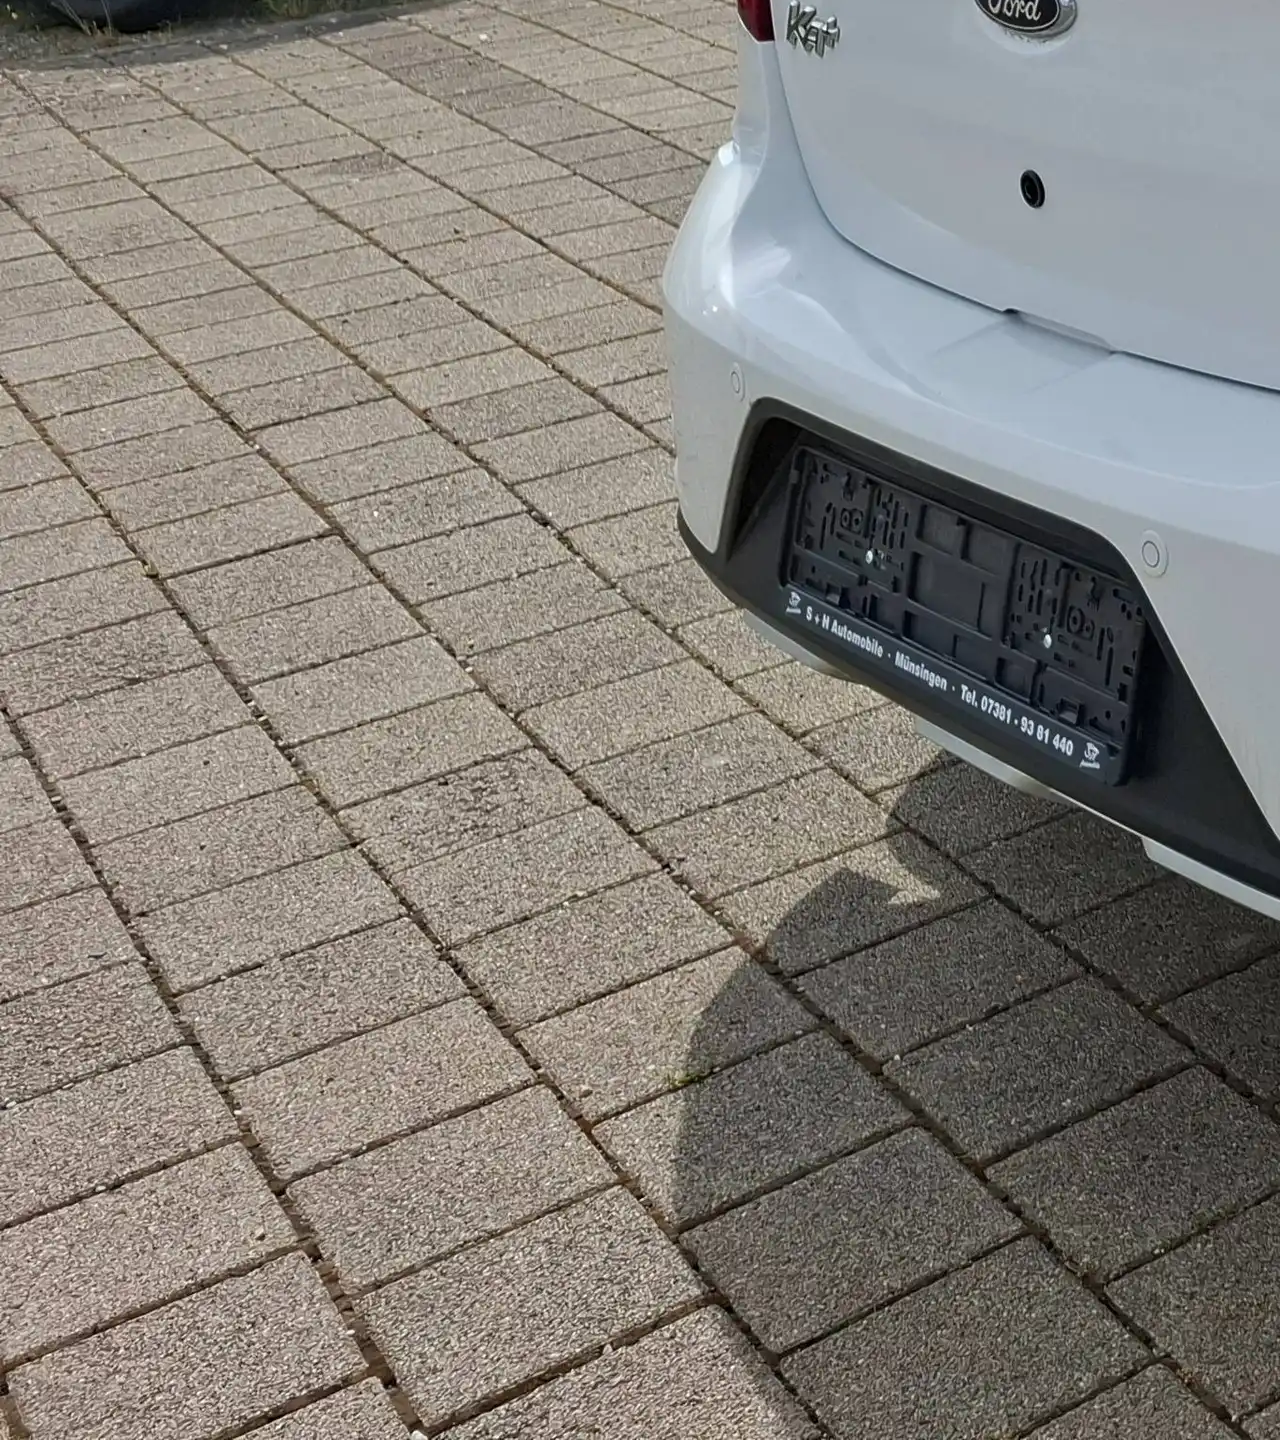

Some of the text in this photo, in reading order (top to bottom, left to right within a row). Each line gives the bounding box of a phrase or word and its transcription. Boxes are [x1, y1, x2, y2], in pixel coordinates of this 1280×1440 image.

[806, 606, 813, 621] S
[822, 614, 830, 630] H
[831, 619, 884, 658] Automobile
[895, 651, 948, 691] Münsingen
[960, 684, 978, 707] Tel.
[981, 695, 1011, 724] 07381
[1021, 716, 1034, 736] 93
[1037, 725, 1049, 744] 81
[1053, 733, 1073, 756] 440
